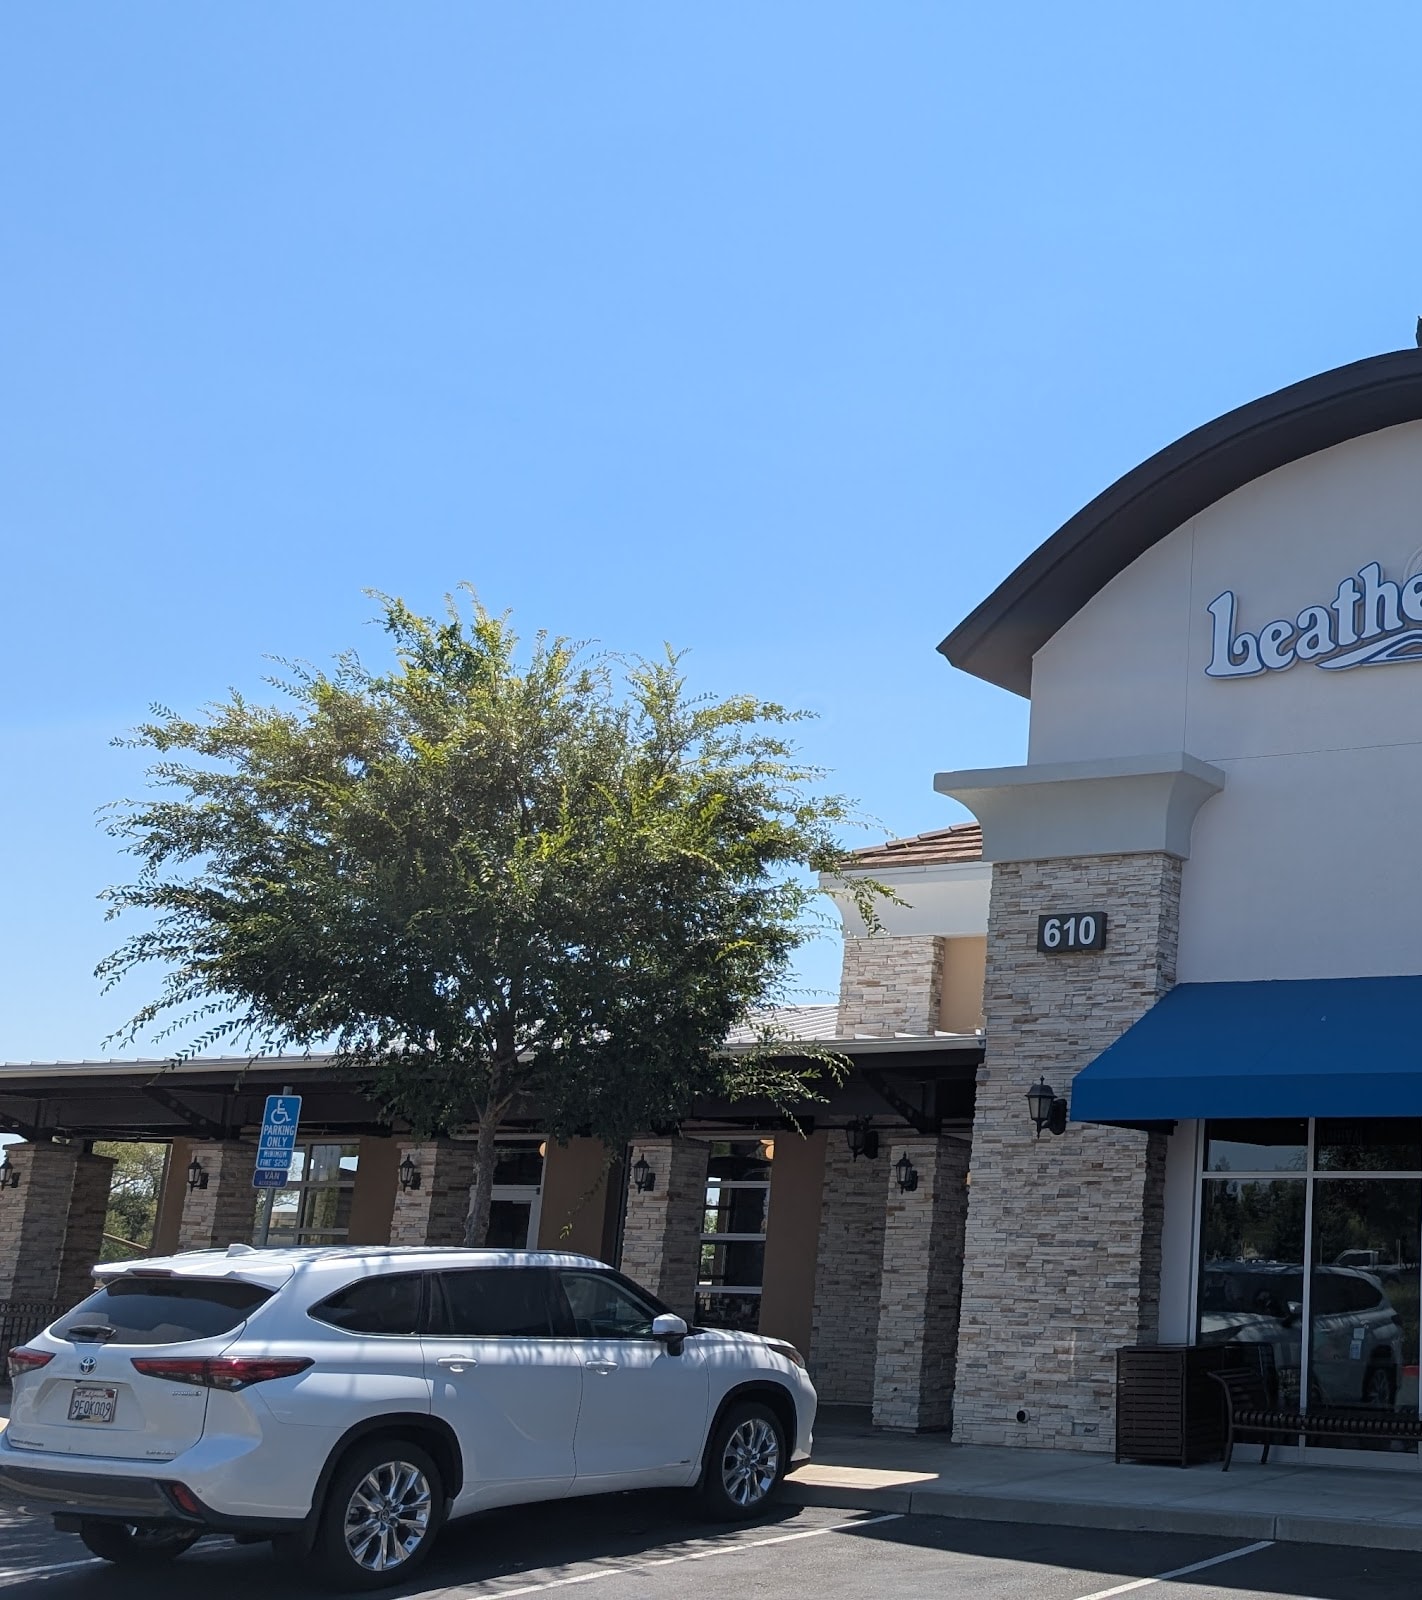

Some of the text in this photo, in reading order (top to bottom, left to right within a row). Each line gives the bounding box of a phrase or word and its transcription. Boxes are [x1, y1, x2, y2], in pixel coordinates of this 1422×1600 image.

[1043, 915, 1096, 948] 610
[263, 1124, 296, 1136] PARKING
[266, 1136, 289, 1147] ONLY
[264, 1171, 281, 1180] VAN
